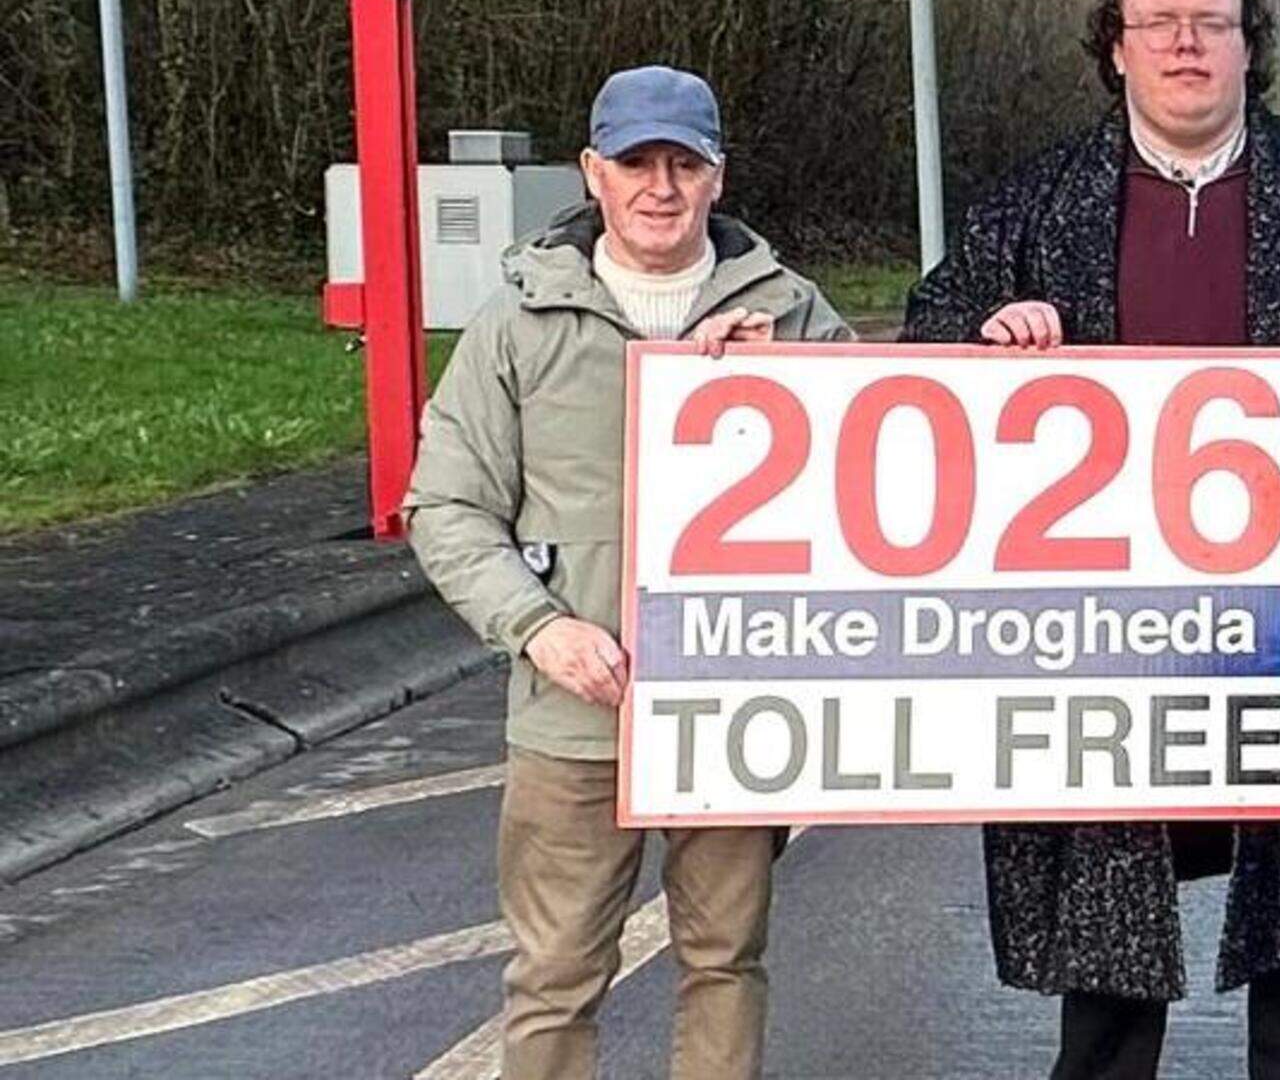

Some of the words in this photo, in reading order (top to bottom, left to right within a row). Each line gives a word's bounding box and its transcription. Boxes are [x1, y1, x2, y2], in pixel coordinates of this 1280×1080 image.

[682, 595, 880, 658] Make
[902, 595, 1257, 670] Drogheda
[651, 694, 954, 794] TOLL
